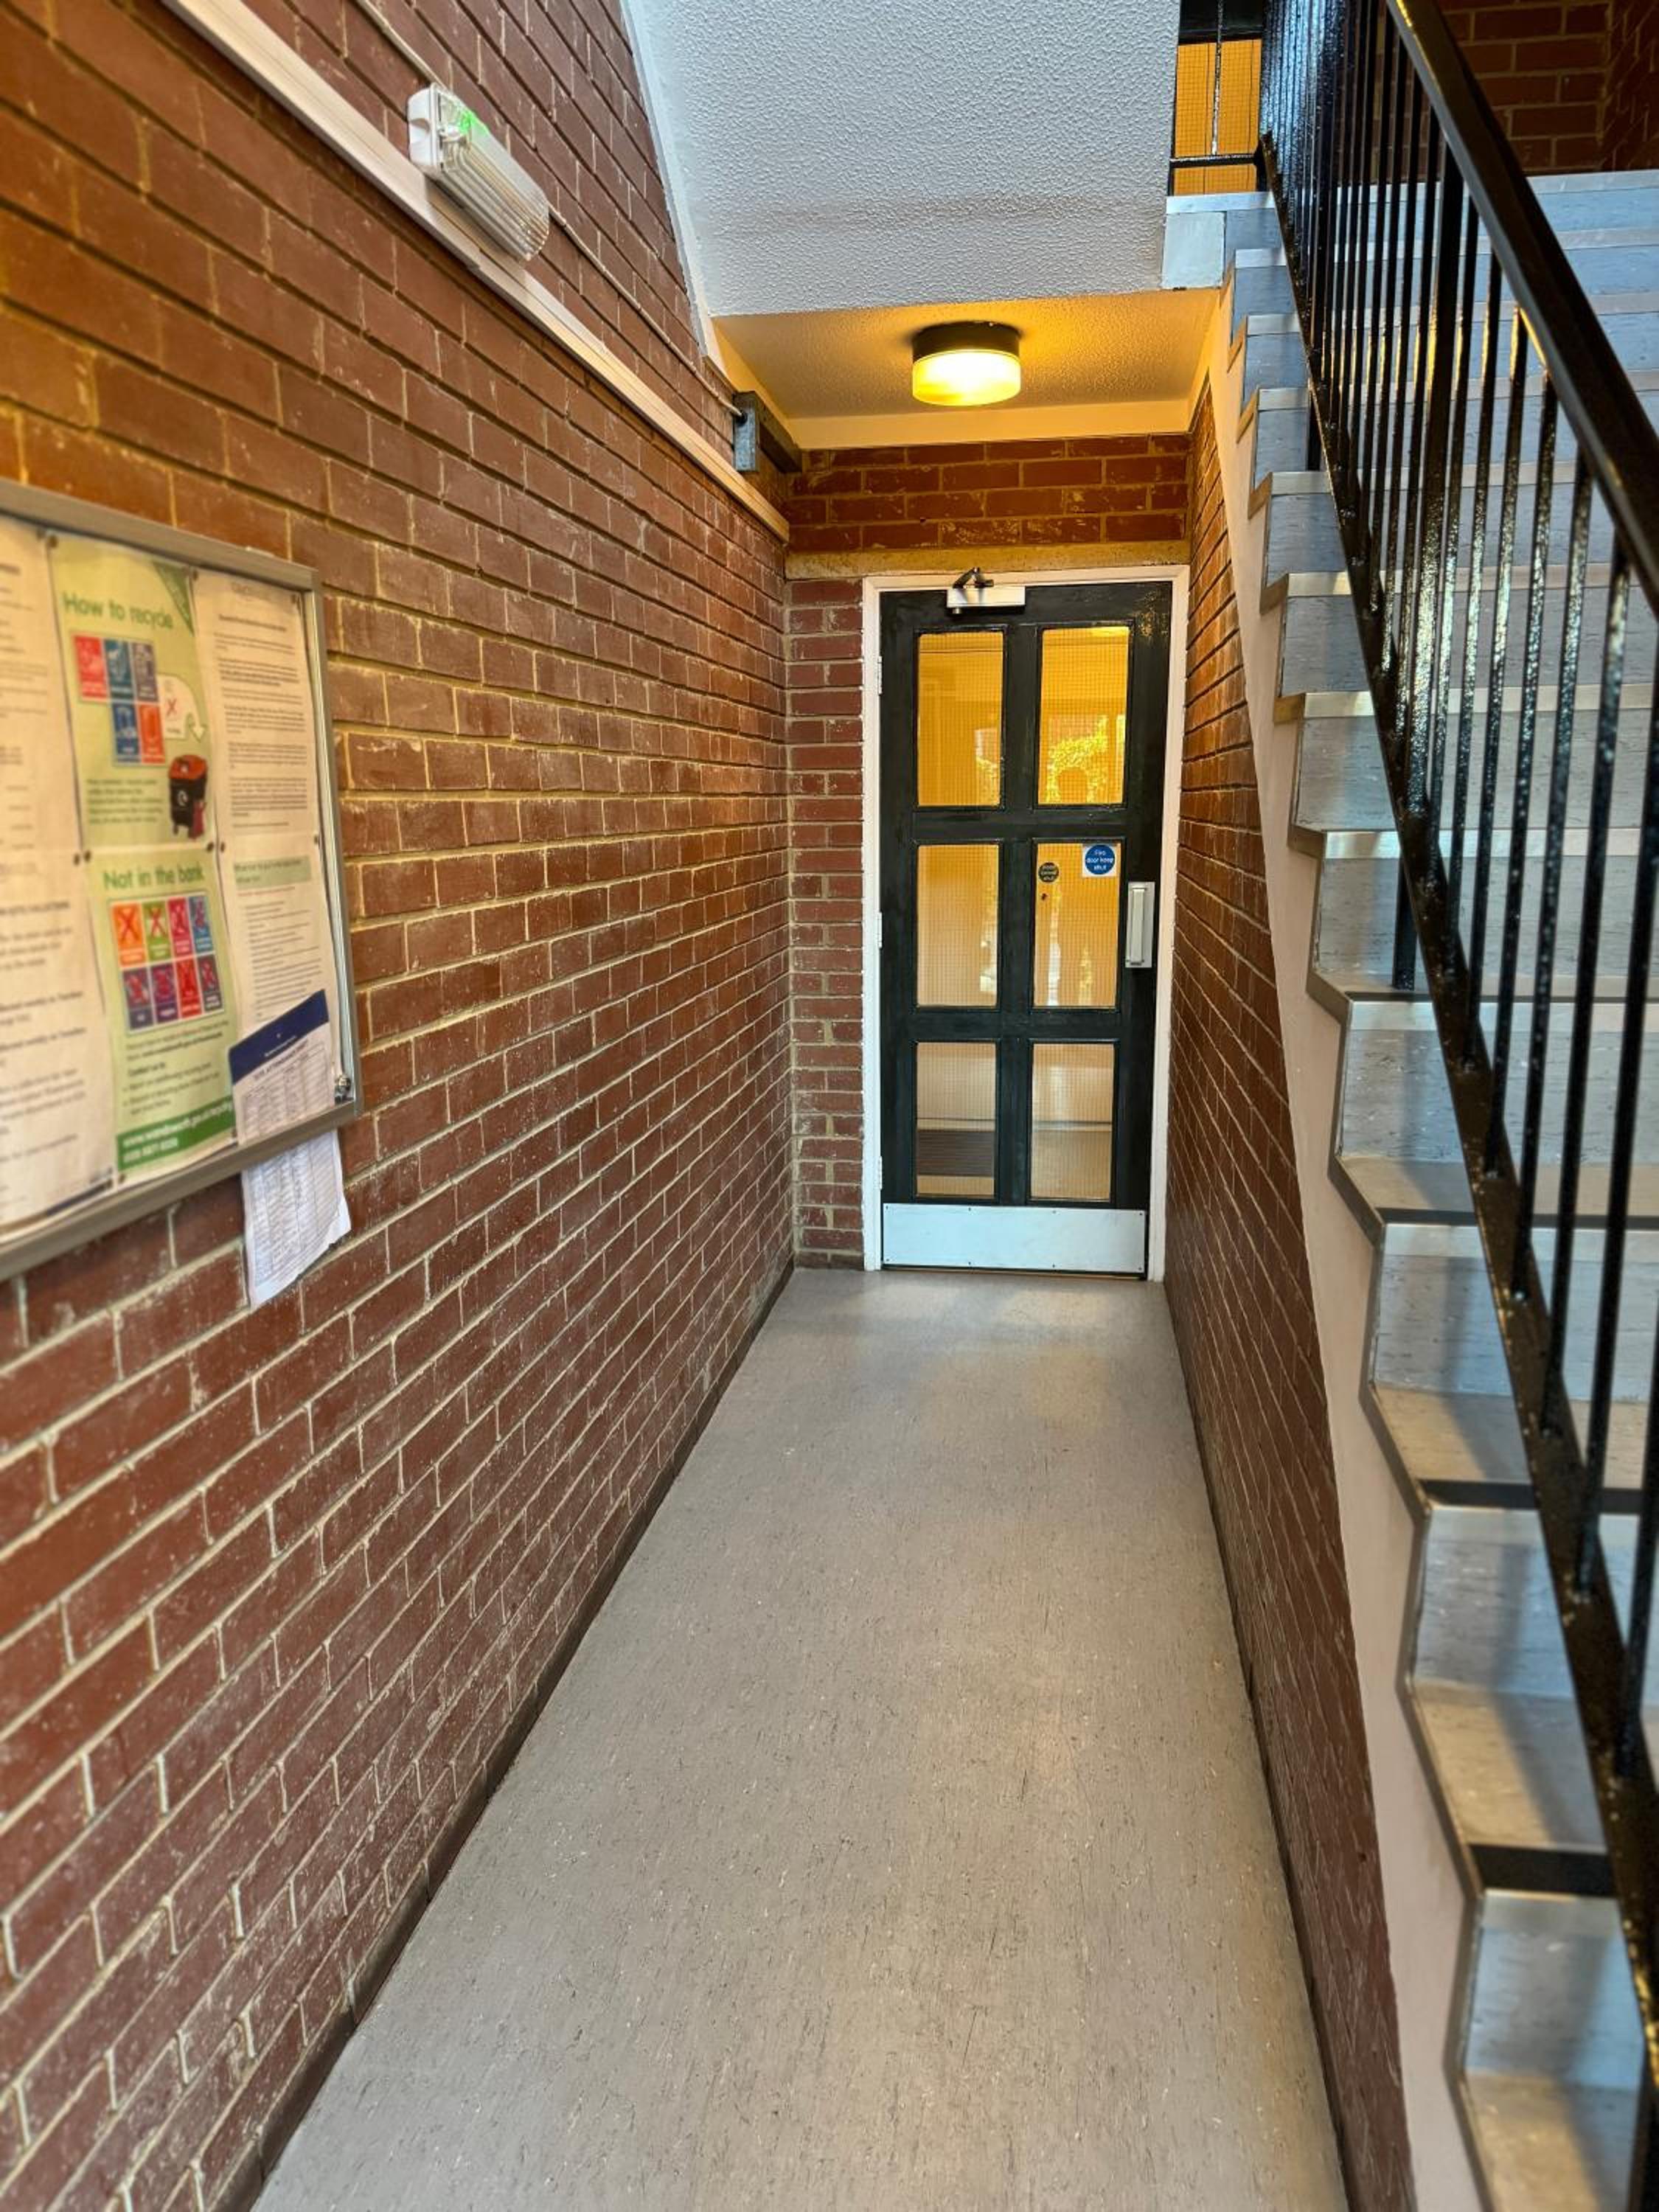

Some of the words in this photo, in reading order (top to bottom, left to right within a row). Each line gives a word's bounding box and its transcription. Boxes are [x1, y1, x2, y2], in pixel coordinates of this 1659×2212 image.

[62, 591, 103, 617] How
[108, 599, 125, 621] to
[129, 606, 174, 630] recycle
[102, 869, 133, 890] Not
[137, 865, 152, 886] in
[155, 864, 175, 885] the
